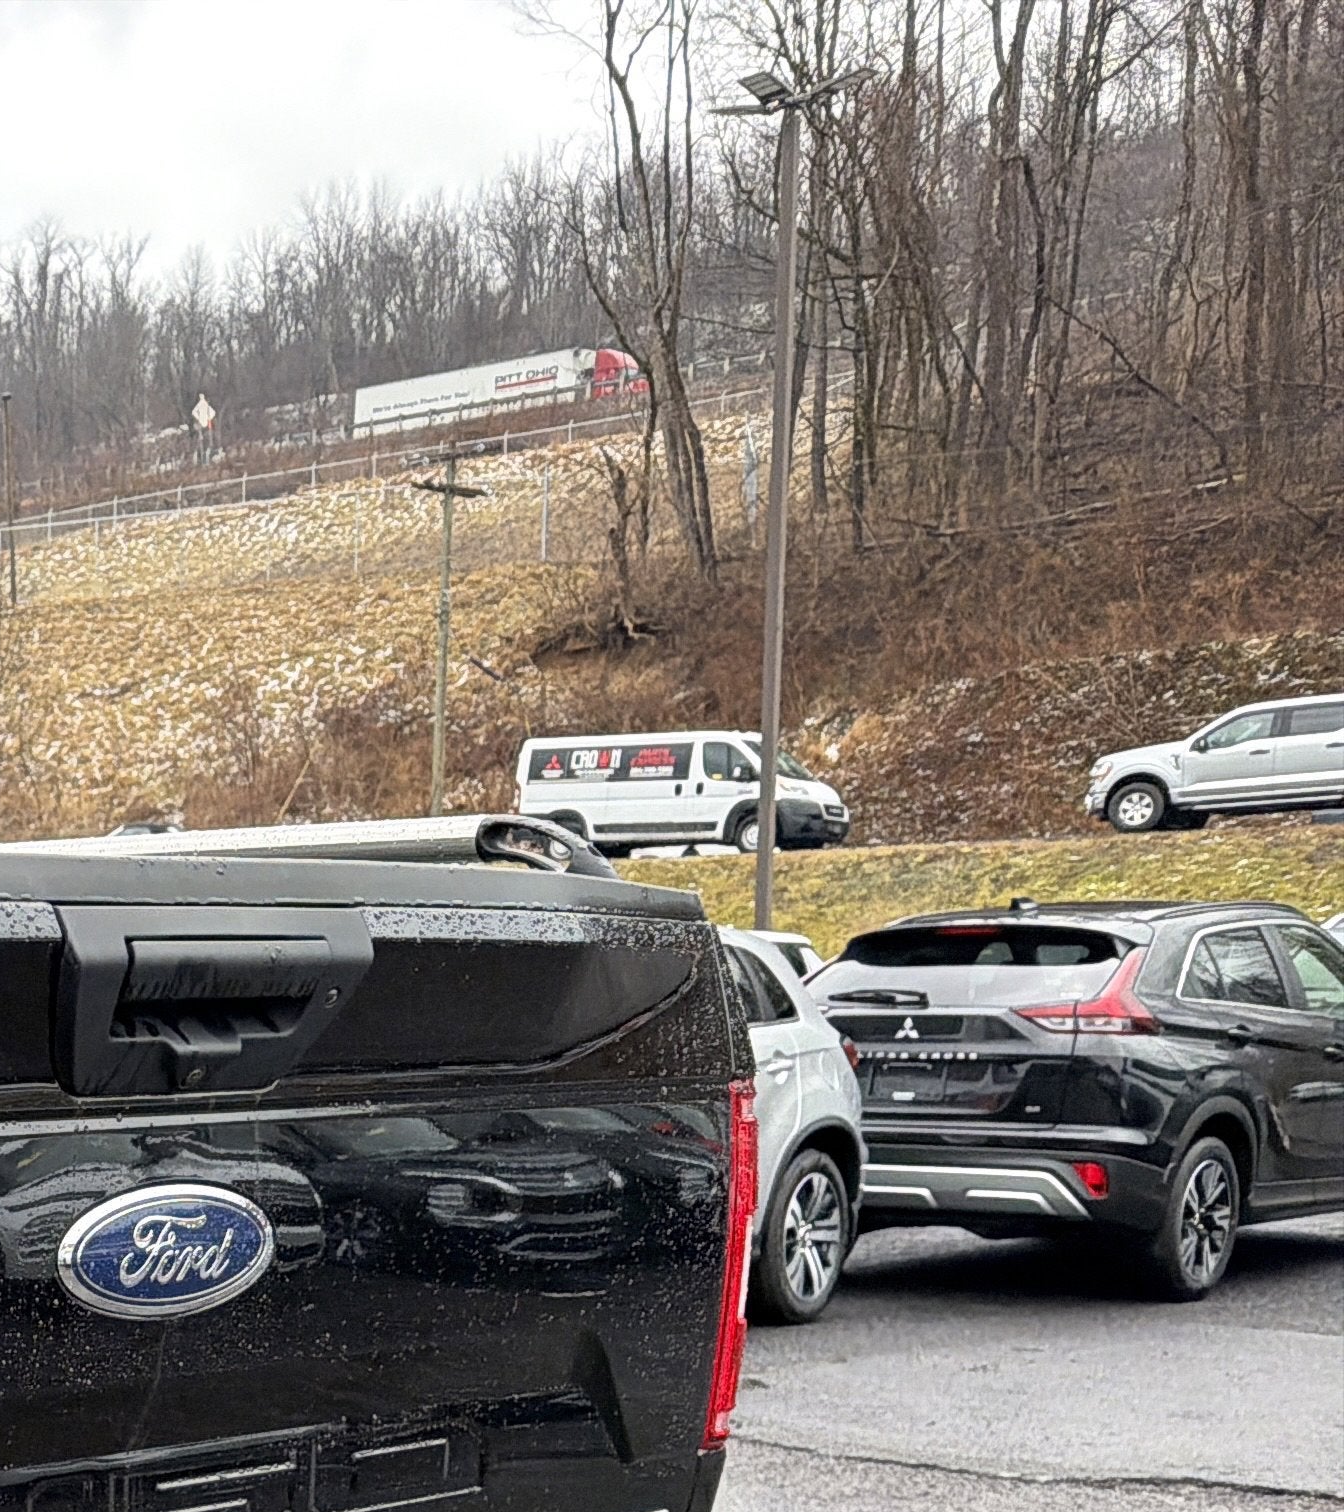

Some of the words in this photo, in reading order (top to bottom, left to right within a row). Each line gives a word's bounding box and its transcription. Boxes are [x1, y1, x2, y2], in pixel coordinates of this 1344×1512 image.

[495, 372, 523, 385] PITT
[526, 365, 559, 380] OHIO
[119, 1213, 234, 1288] Ford
